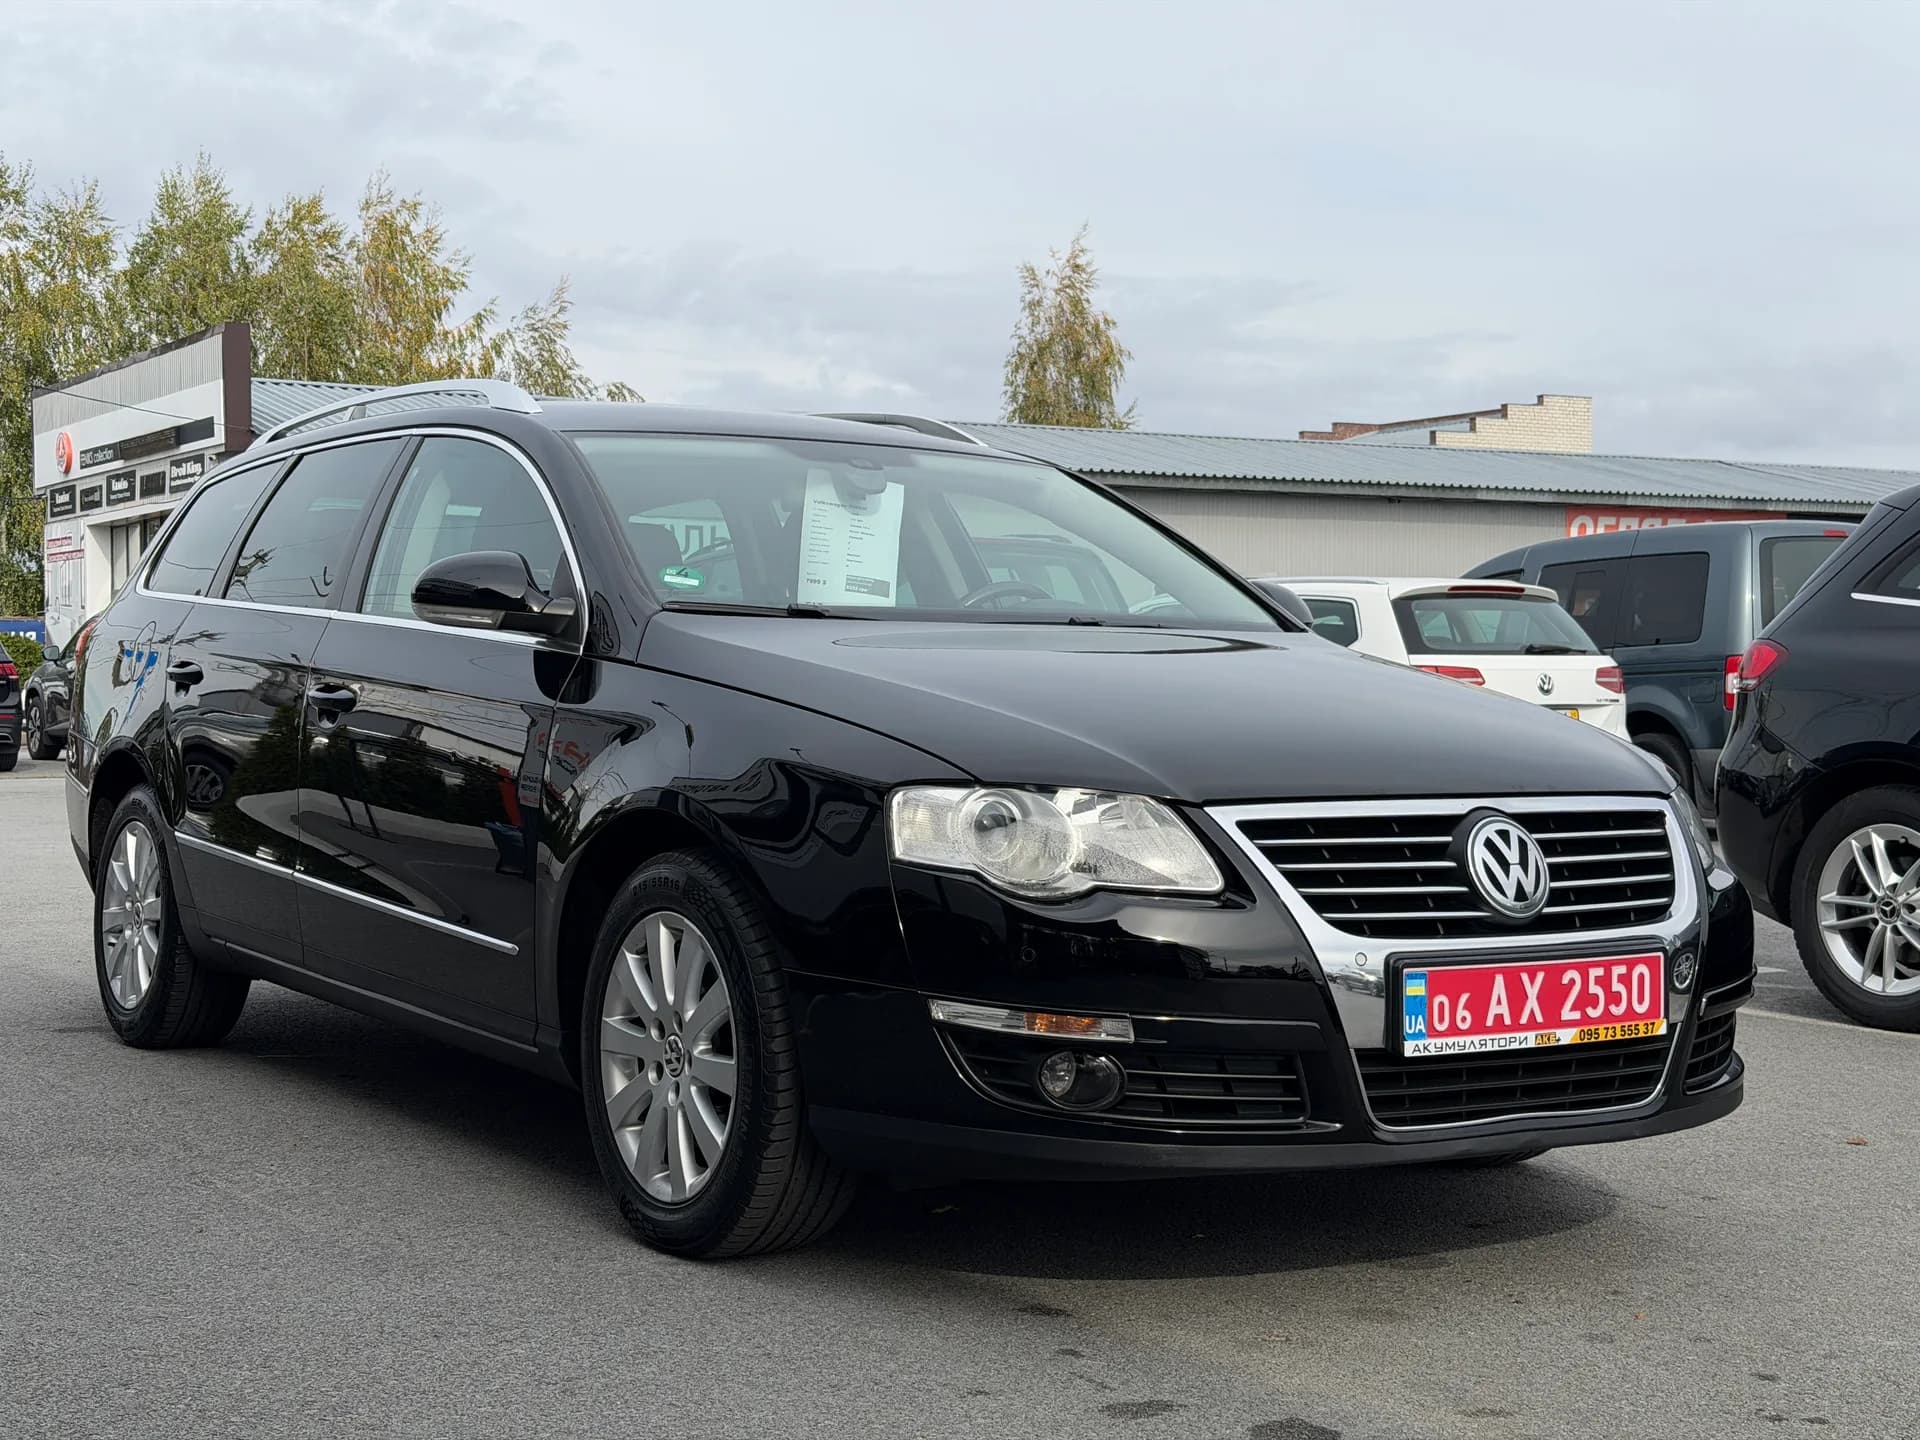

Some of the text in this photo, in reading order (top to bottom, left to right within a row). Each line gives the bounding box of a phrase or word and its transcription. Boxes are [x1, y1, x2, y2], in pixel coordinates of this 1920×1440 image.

[186, 460, 202, 475] King
[1432, 963, 1651, 1032] 06 AX 2550
[1405, 1015, 1426, 1034] UA
[1411, 1036, 1529, 1055] АКУМУЛЯТОРИ
[1578, 1028, 1601, 1041] 095
[1603, 1026, 1618, 1039] 73
[1620, 1024, 1641, 1037] 555
[1642, 1022, 1657, 1035] 37
